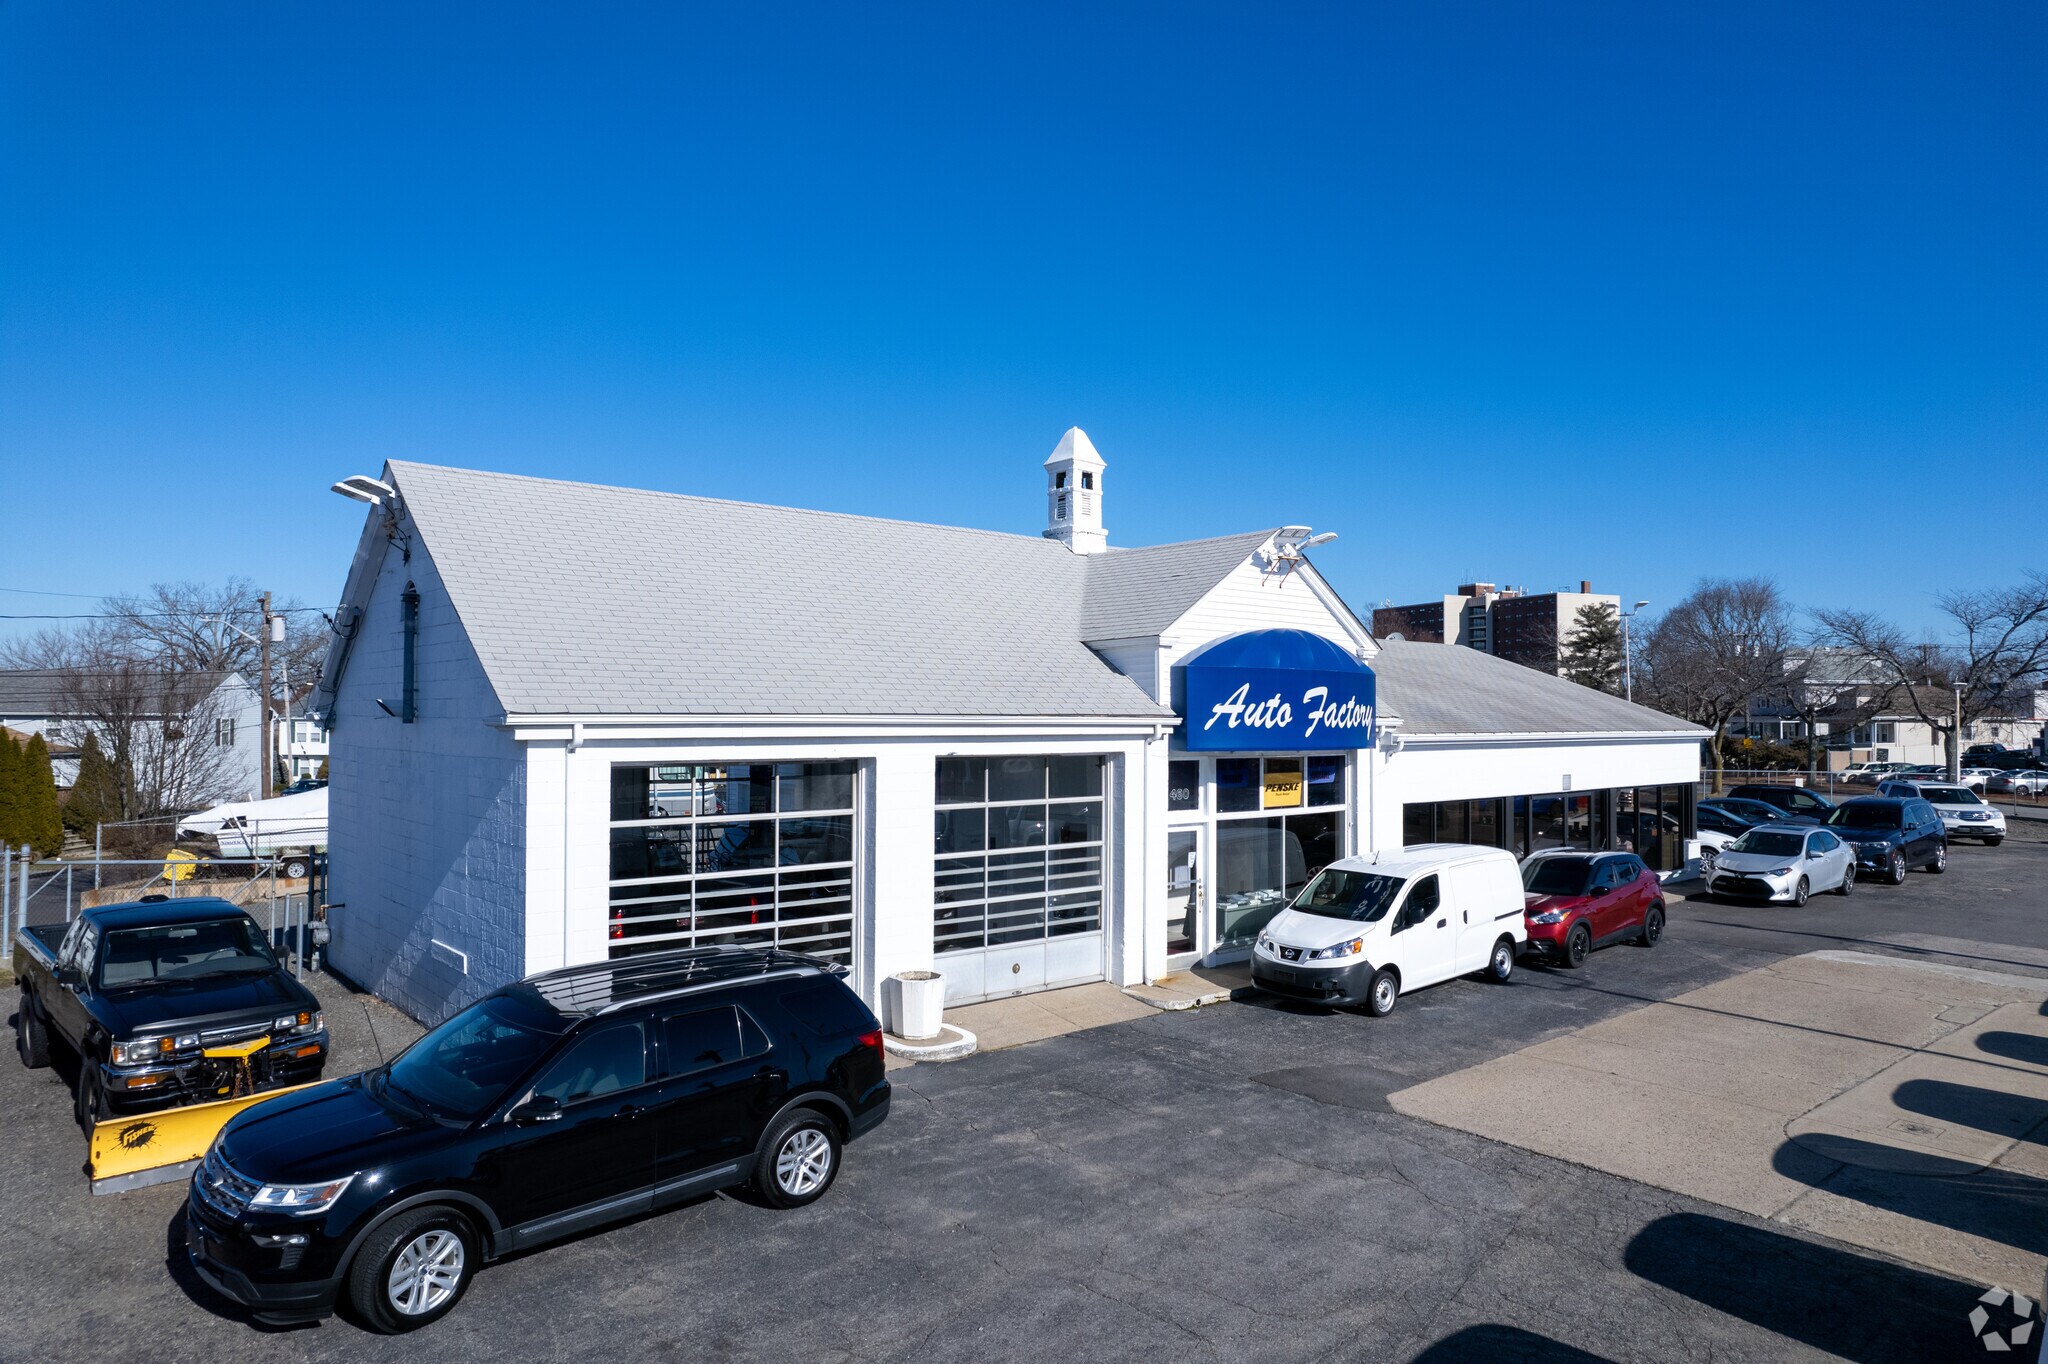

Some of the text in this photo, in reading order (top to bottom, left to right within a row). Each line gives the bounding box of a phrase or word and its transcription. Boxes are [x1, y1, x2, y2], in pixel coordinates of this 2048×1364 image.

[1203, 682, 1373, 741] Auto Factory
[1265, 782, 1300, 793] PENSKE
[123, 1125, 156, 1146] FISHER
